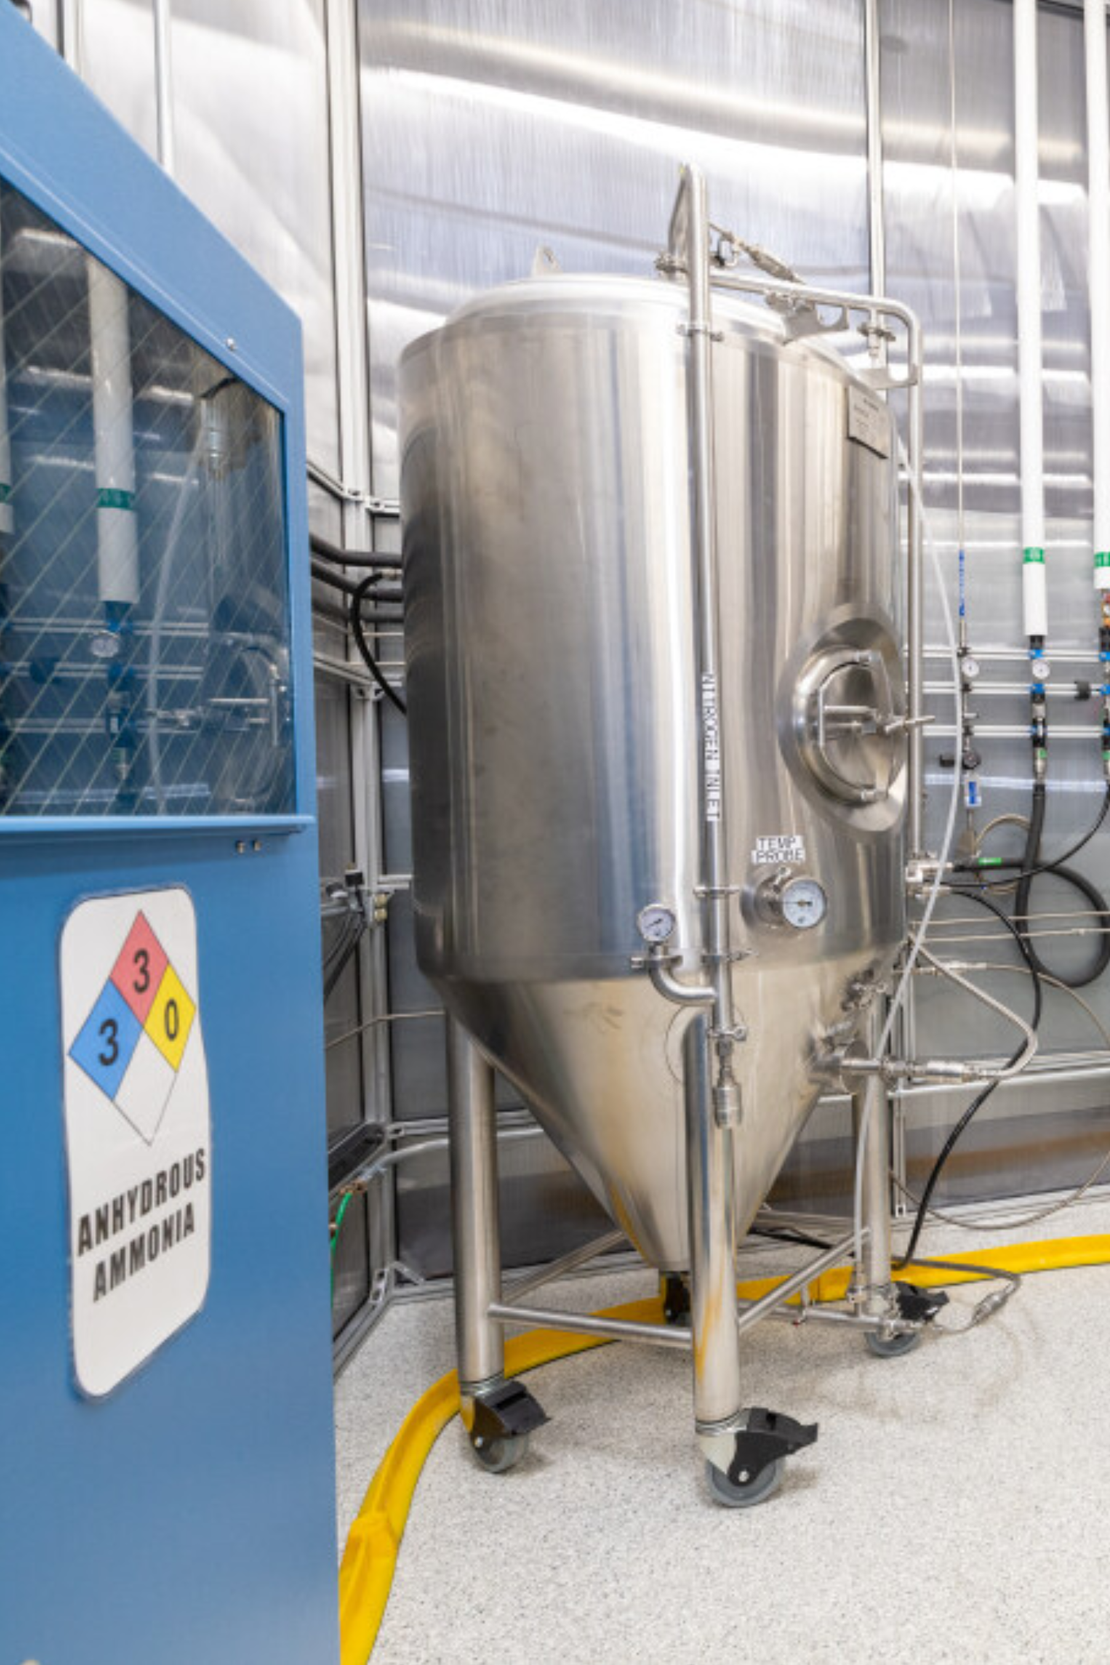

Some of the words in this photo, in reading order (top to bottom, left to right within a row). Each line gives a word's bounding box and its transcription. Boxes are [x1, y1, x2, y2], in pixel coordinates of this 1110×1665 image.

[702, 674, 719, 760] NITROGEN
[705, 769, 720, 818] INLET
[756, 848, 804, 862] PROBE
[759, 836, 797, 849] TEMP
[132, 949, 151, 993] 3
[98, 1018, 119, 1067] 3
[164, 998, 180, 1042] 0
[77, 1147, 207, 1257] ANHYDROUS
[93, 1201, 196, 1303] AMMONIA
